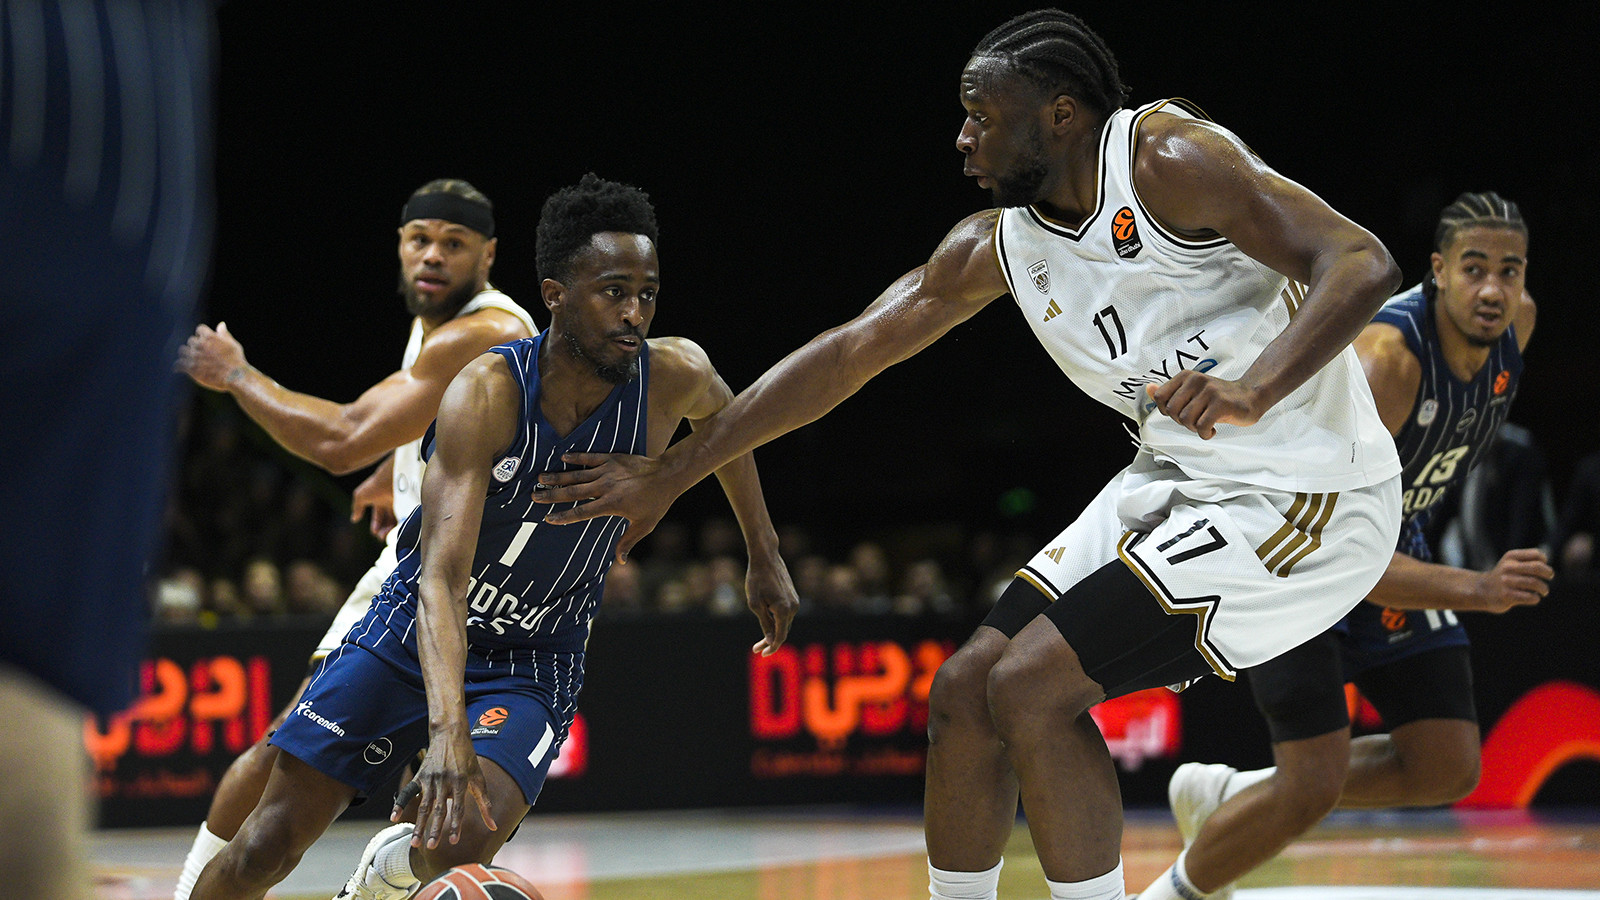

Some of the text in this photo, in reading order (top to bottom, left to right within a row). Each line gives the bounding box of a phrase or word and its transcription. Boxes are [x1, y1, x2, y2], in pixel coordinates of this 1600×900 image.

[1092, 305, 1127, 361] 17
[1412, 445, 1468, 487] 13
[498, 521, 538, 567] 1
[1156, 517, 1228, 566] 17
[303, 707, 345, 738] corendon
[528, 721, 555, 768] 1
